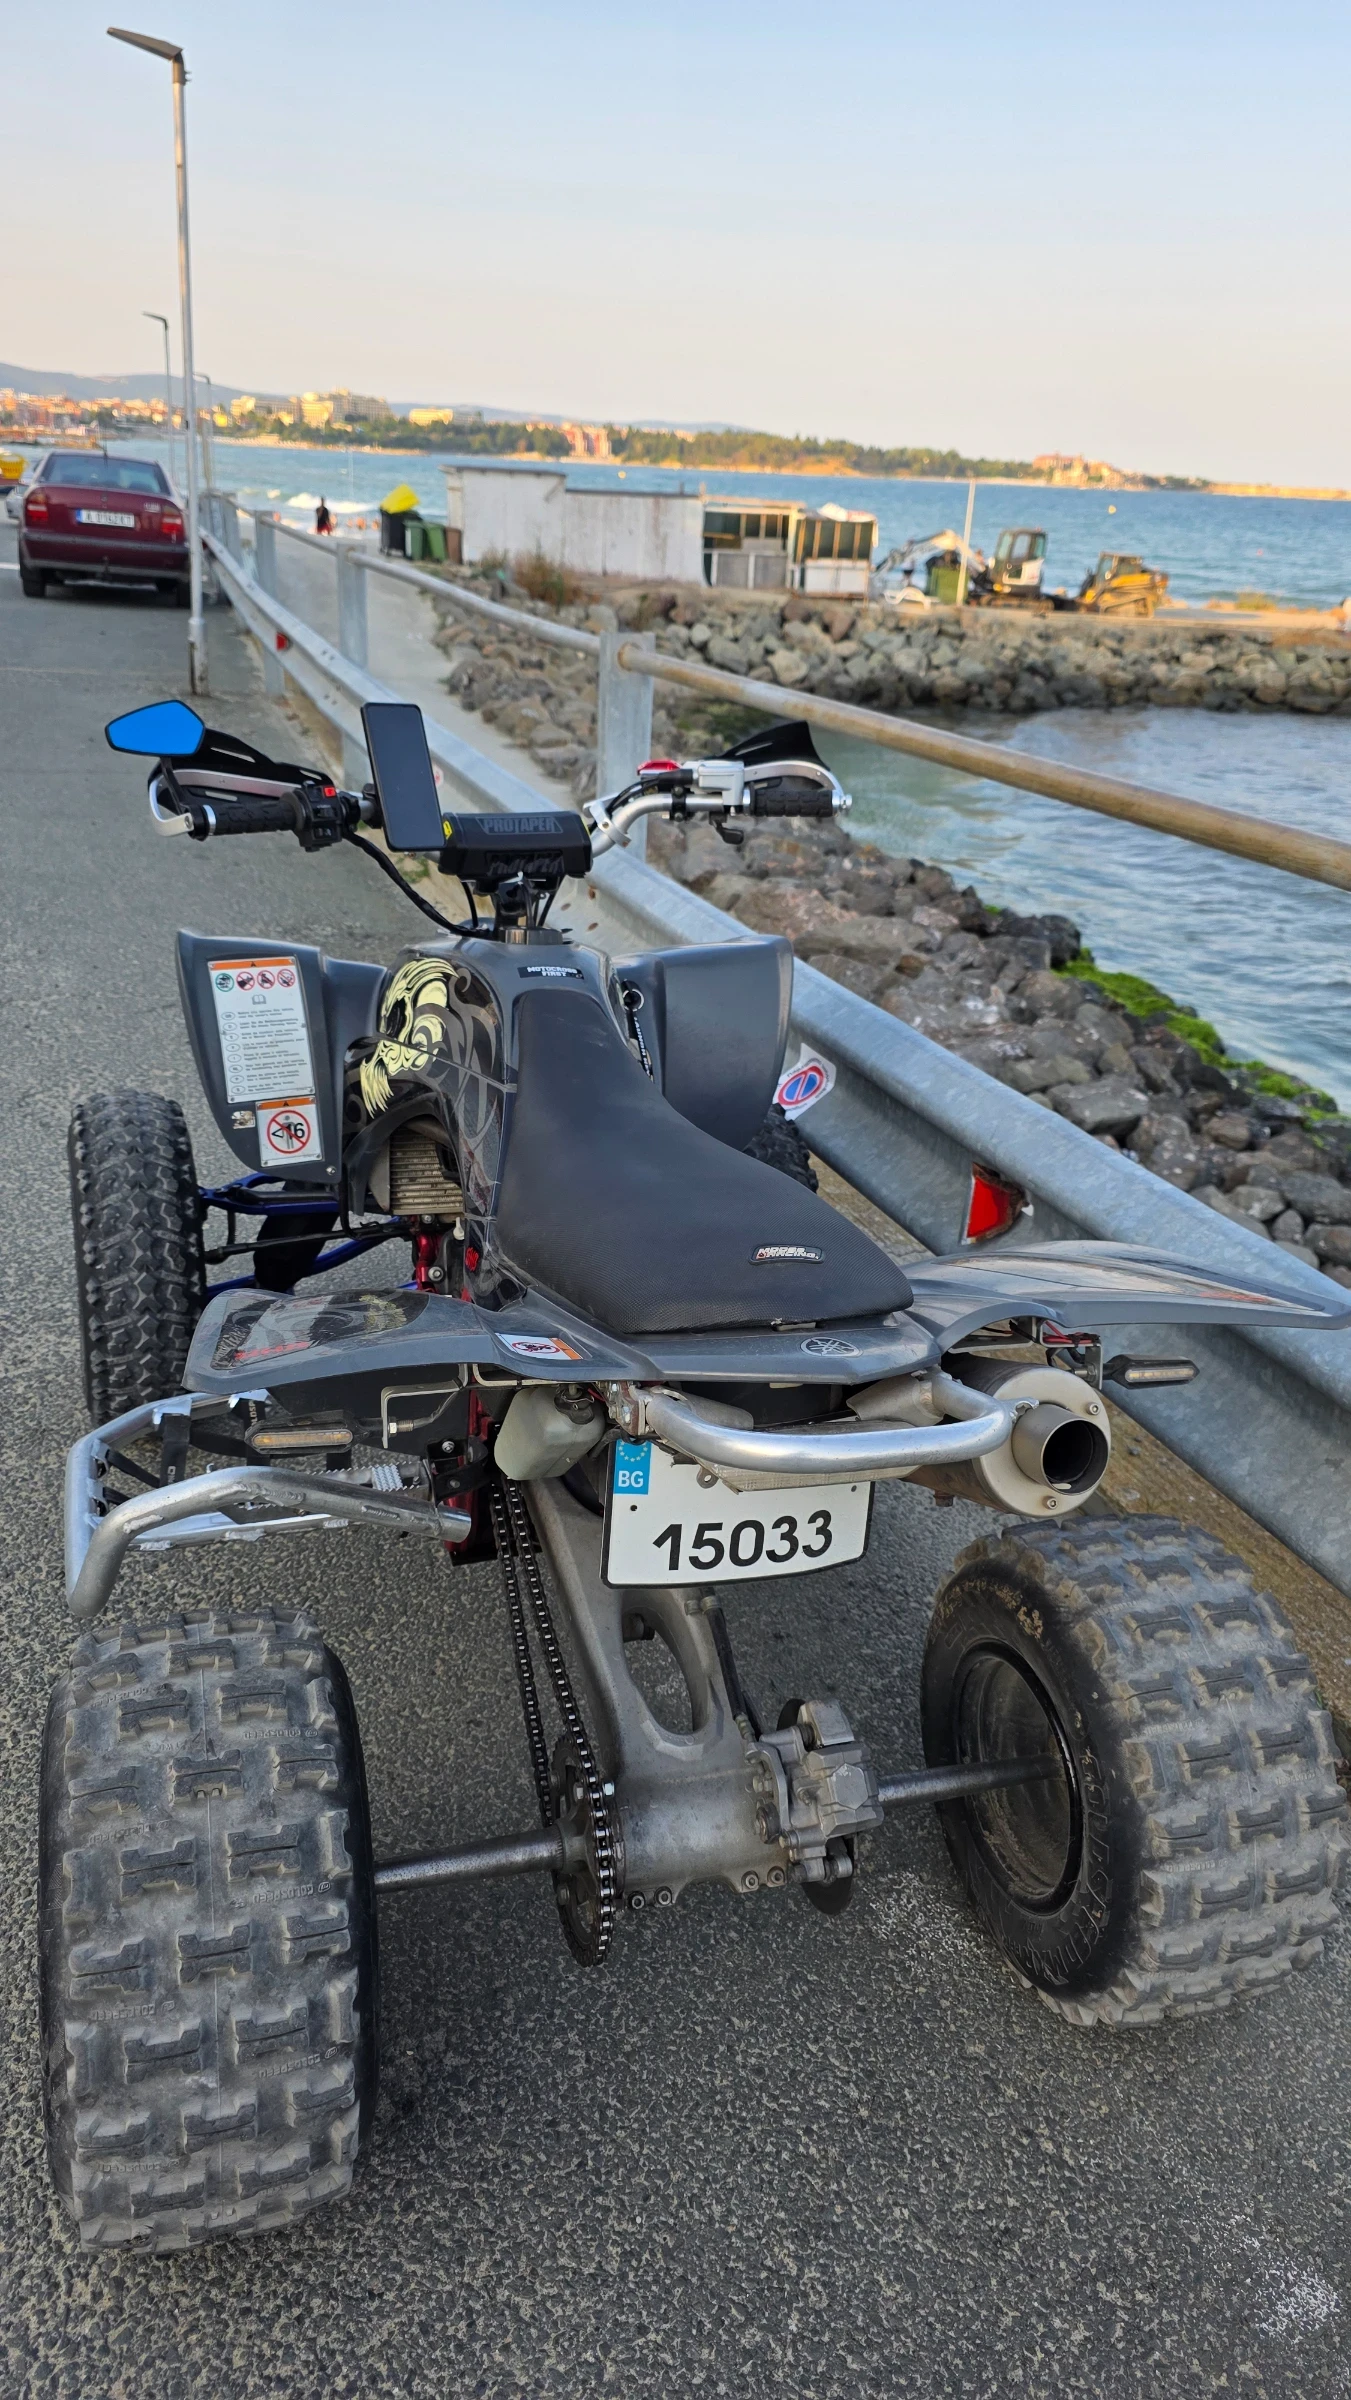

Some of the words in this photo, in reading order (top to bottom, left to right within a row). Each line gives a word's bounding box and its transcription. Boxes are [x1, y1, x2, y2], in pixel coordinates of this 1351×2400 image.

[483, 817, 556, 833] PROTAPER
[527, 966, 578, 974] MOTOCROSS
[617, 1470, 644, 1488] BG
[652, 1509, 833, 1572] 15033
[243, 1728, 302, 1740] GOLDSPEED
[253, 1883, 314, 1904] GOLDSPEED
[91, 2003, 156, 2022] GOLDSPEED
[258, 2054, 321, 2078] GOLDSPEED
